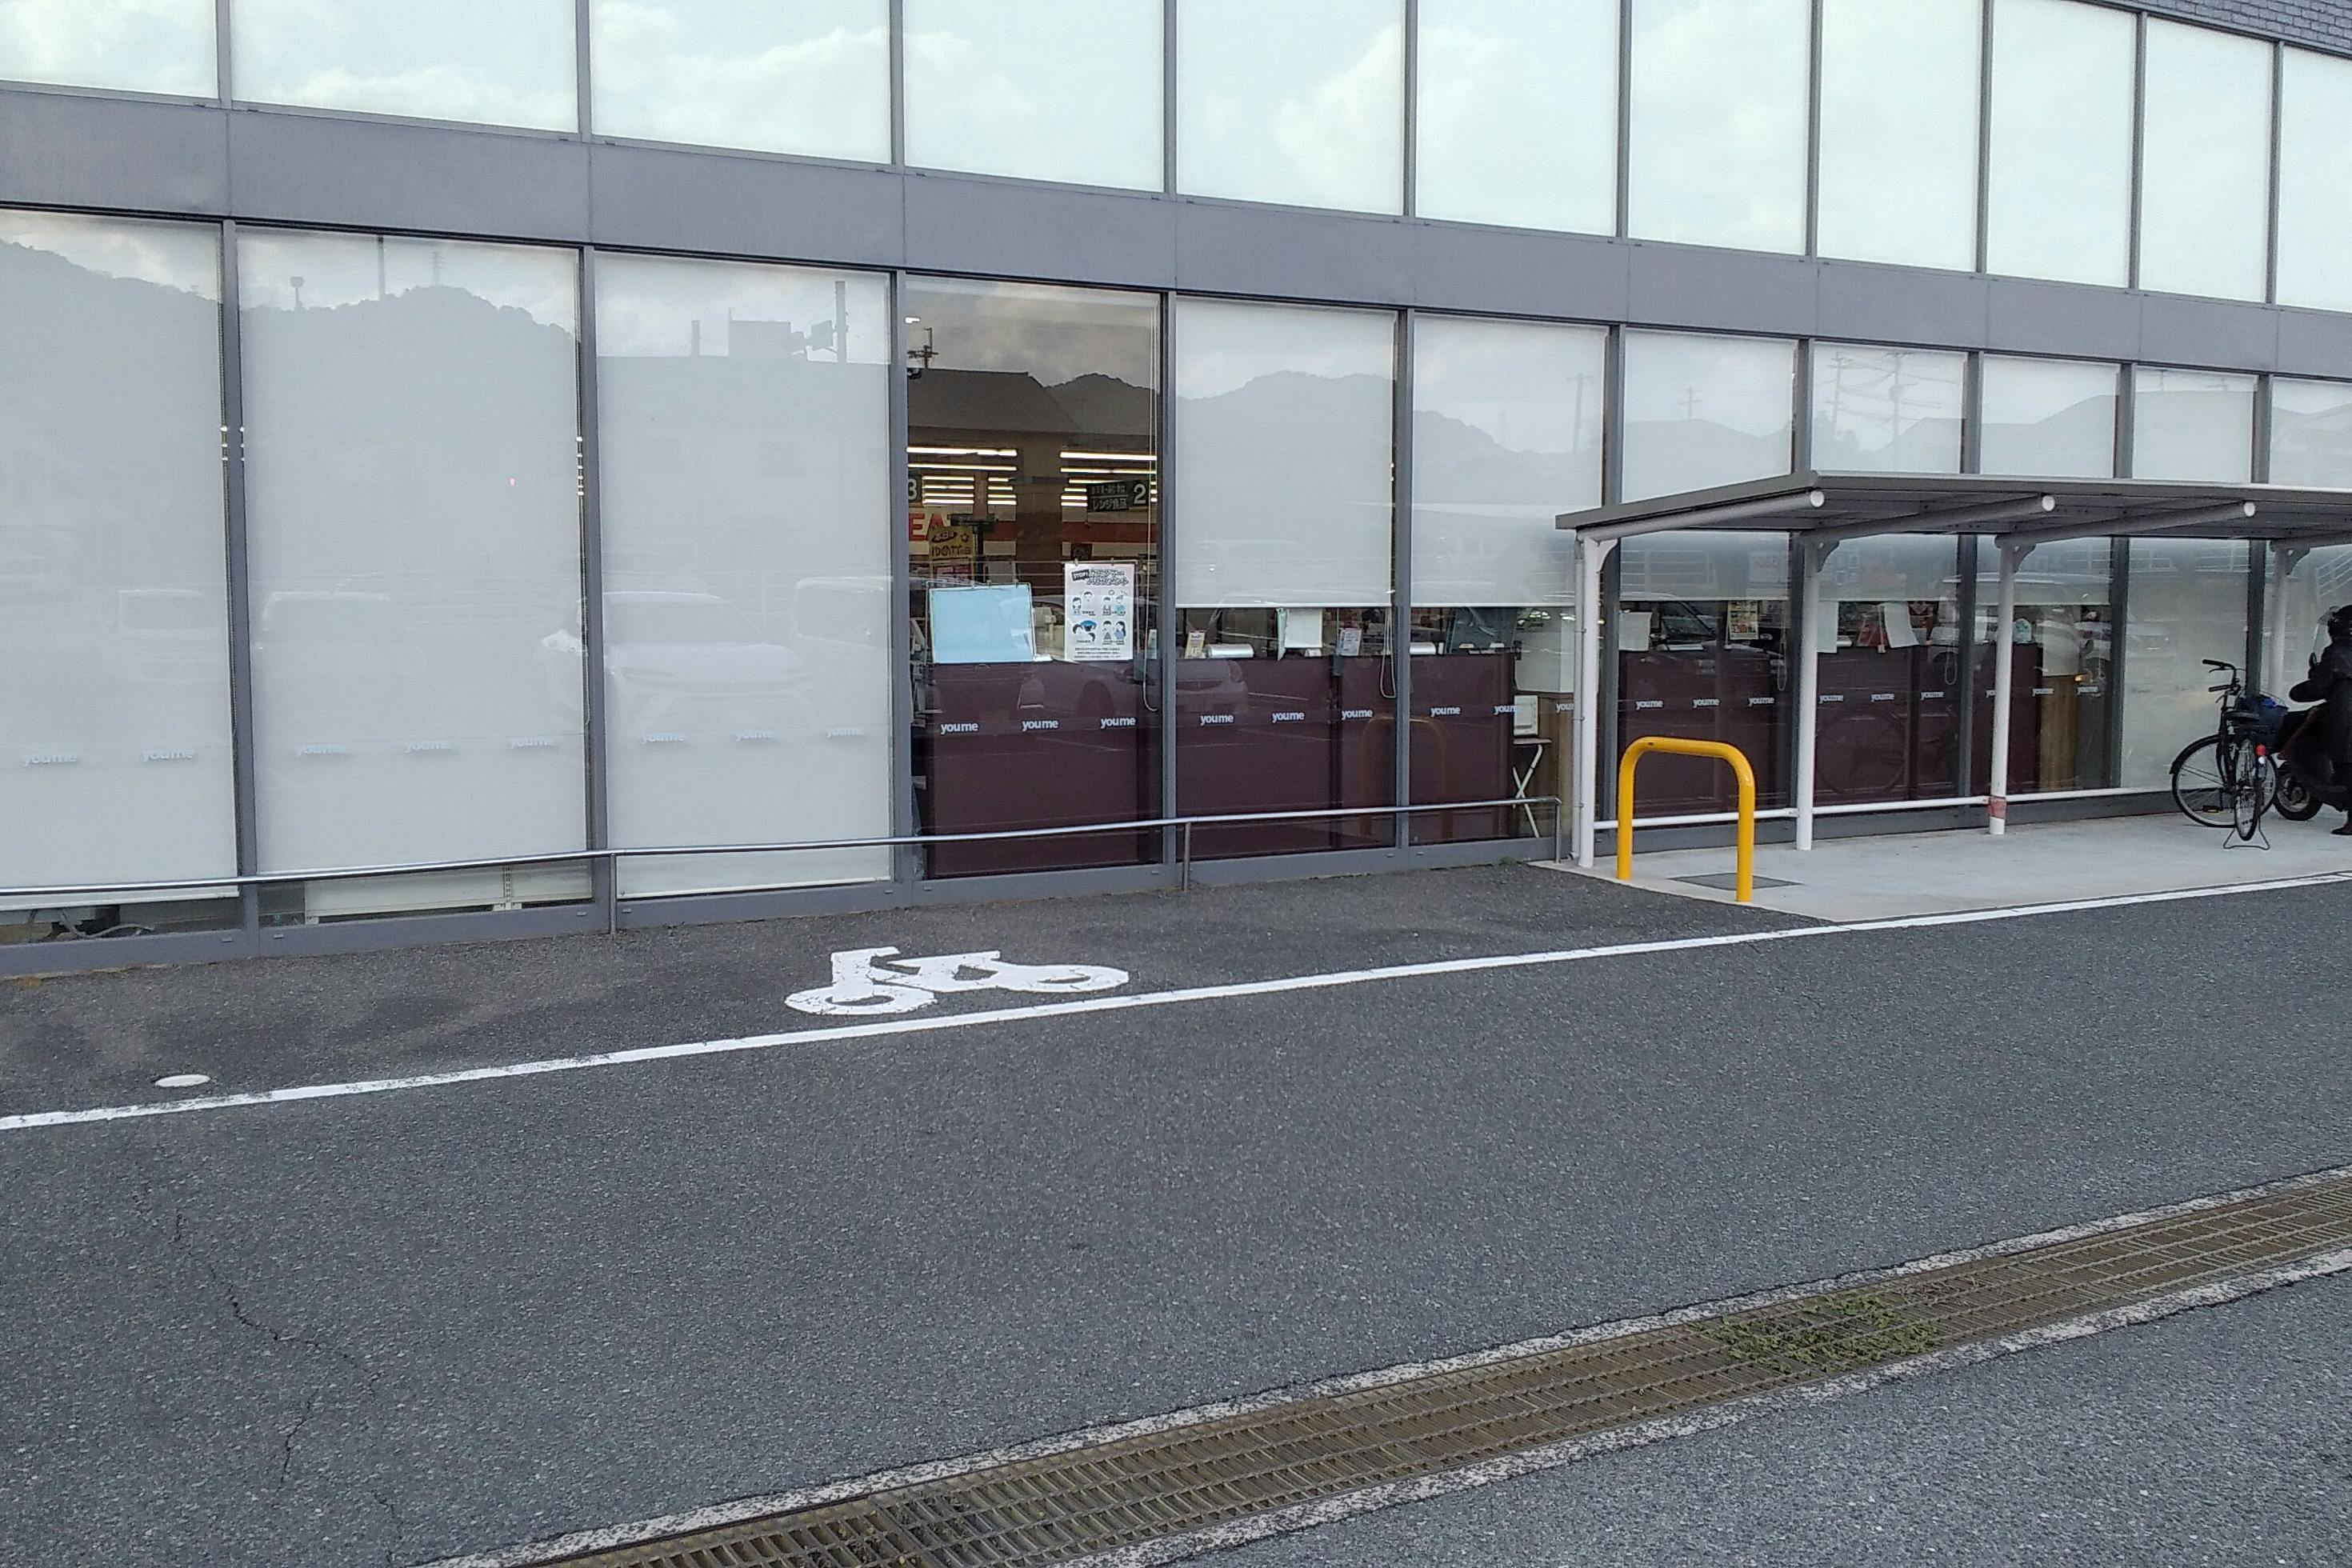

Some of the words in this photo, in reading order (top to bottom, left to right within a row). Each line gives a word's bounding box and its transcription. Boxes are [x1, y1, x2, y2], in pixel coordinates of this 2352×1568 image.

[908, 478, 918, 501] 3
[1133, 483, 1146, 505] 2
[1635, 699, 1663, 710] youme
[1693, 698, 1720, 709] youme
[1748, 696, 1774, 707] youme
[1818, 694, 1844, 704] youme
[1870, 692, 1895, 702] youme
[1921, 690, 1944, 701] youme
[1200, 714, 1234, 726] youme
[1272, 711, 1305, 723] youme
[1342, 709, 1373, 721] youme
[1430, 706, 1461, 718] youme
[940, 721, 979, 734] youme
[1022, 718, 1059, 732] youme
[1100, 716, 1136, 729] youme
[142, 747, 194, 761] youme
